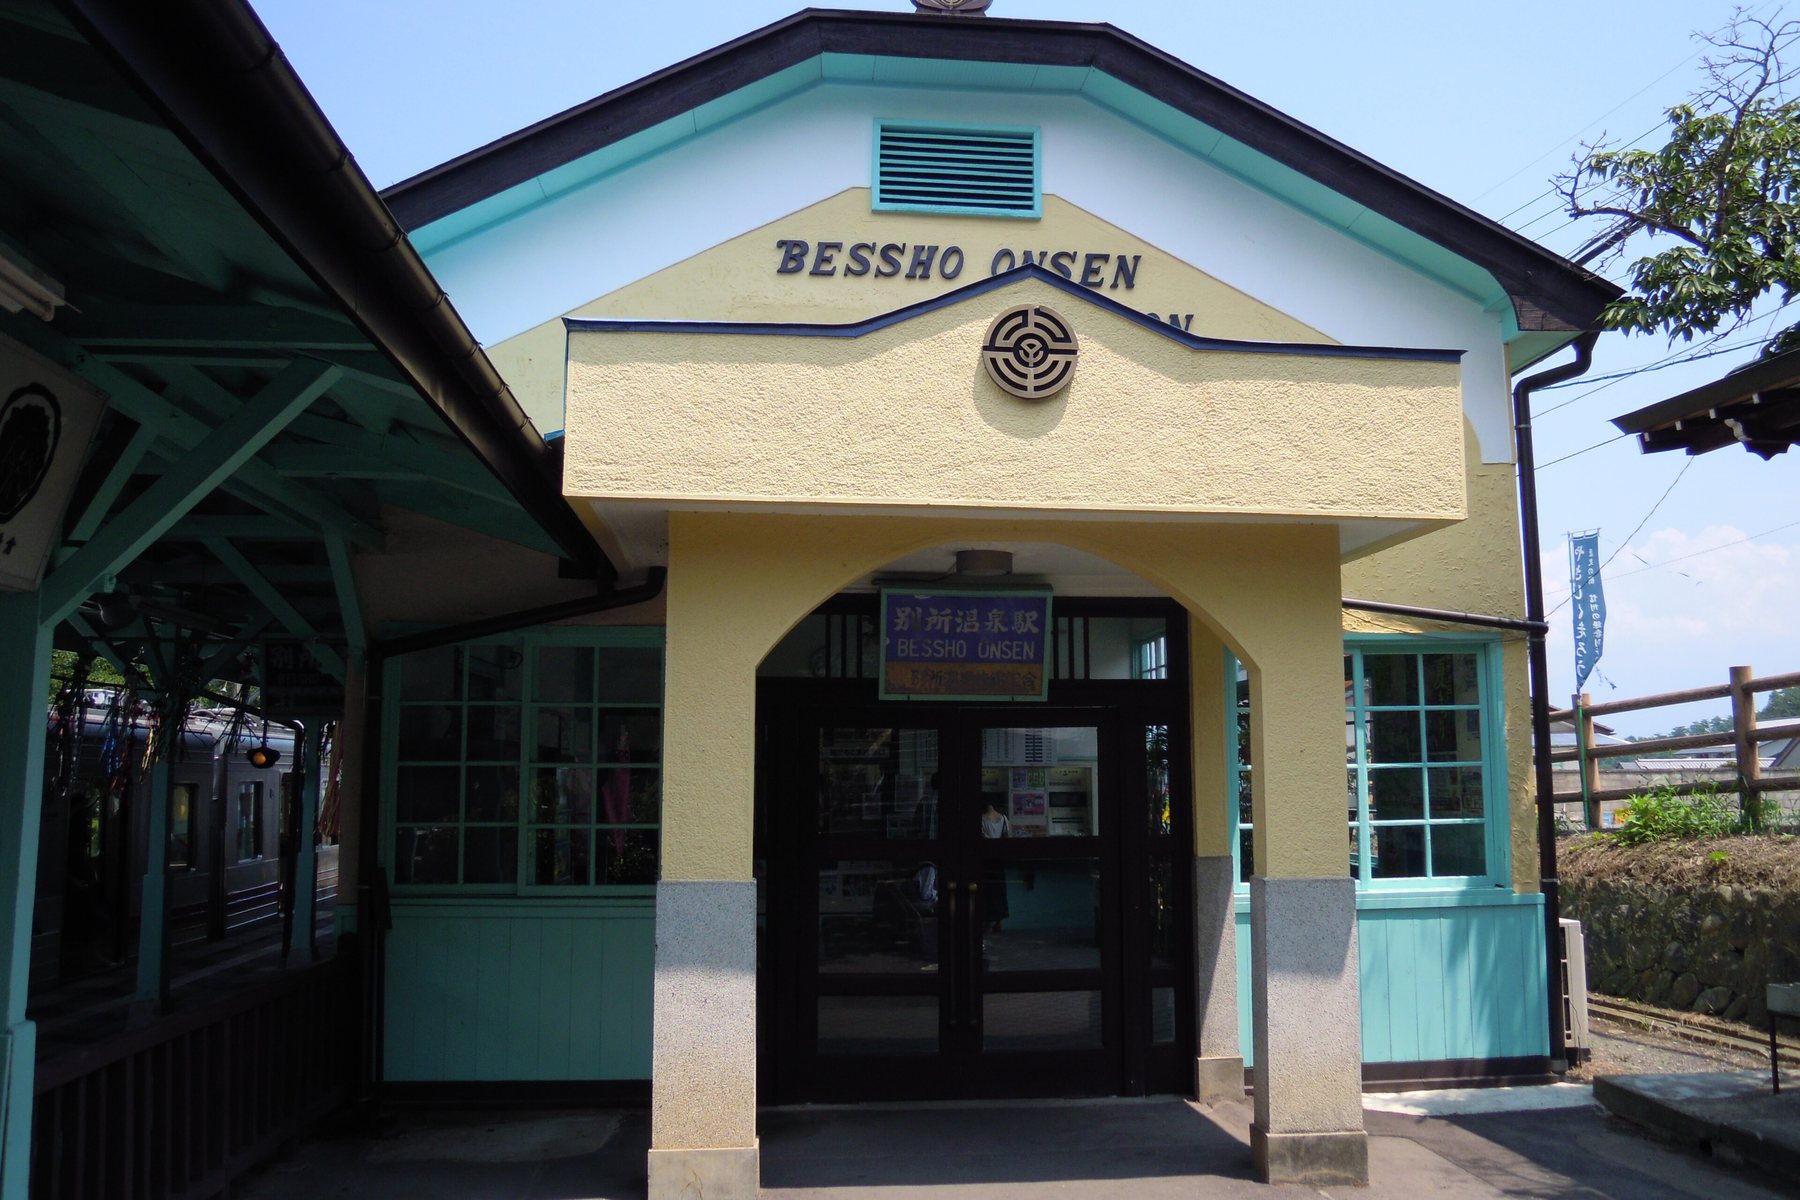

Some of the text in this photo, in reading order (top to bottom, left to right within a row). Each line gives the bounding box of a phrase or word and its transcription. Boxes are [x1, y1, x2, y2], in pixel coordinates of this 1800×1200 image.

[777, 239, 965, 281] BESSHO
[894, 607, 1039, 634] 別所温泉駅
[897, 637, 967, 658] BESSHO
